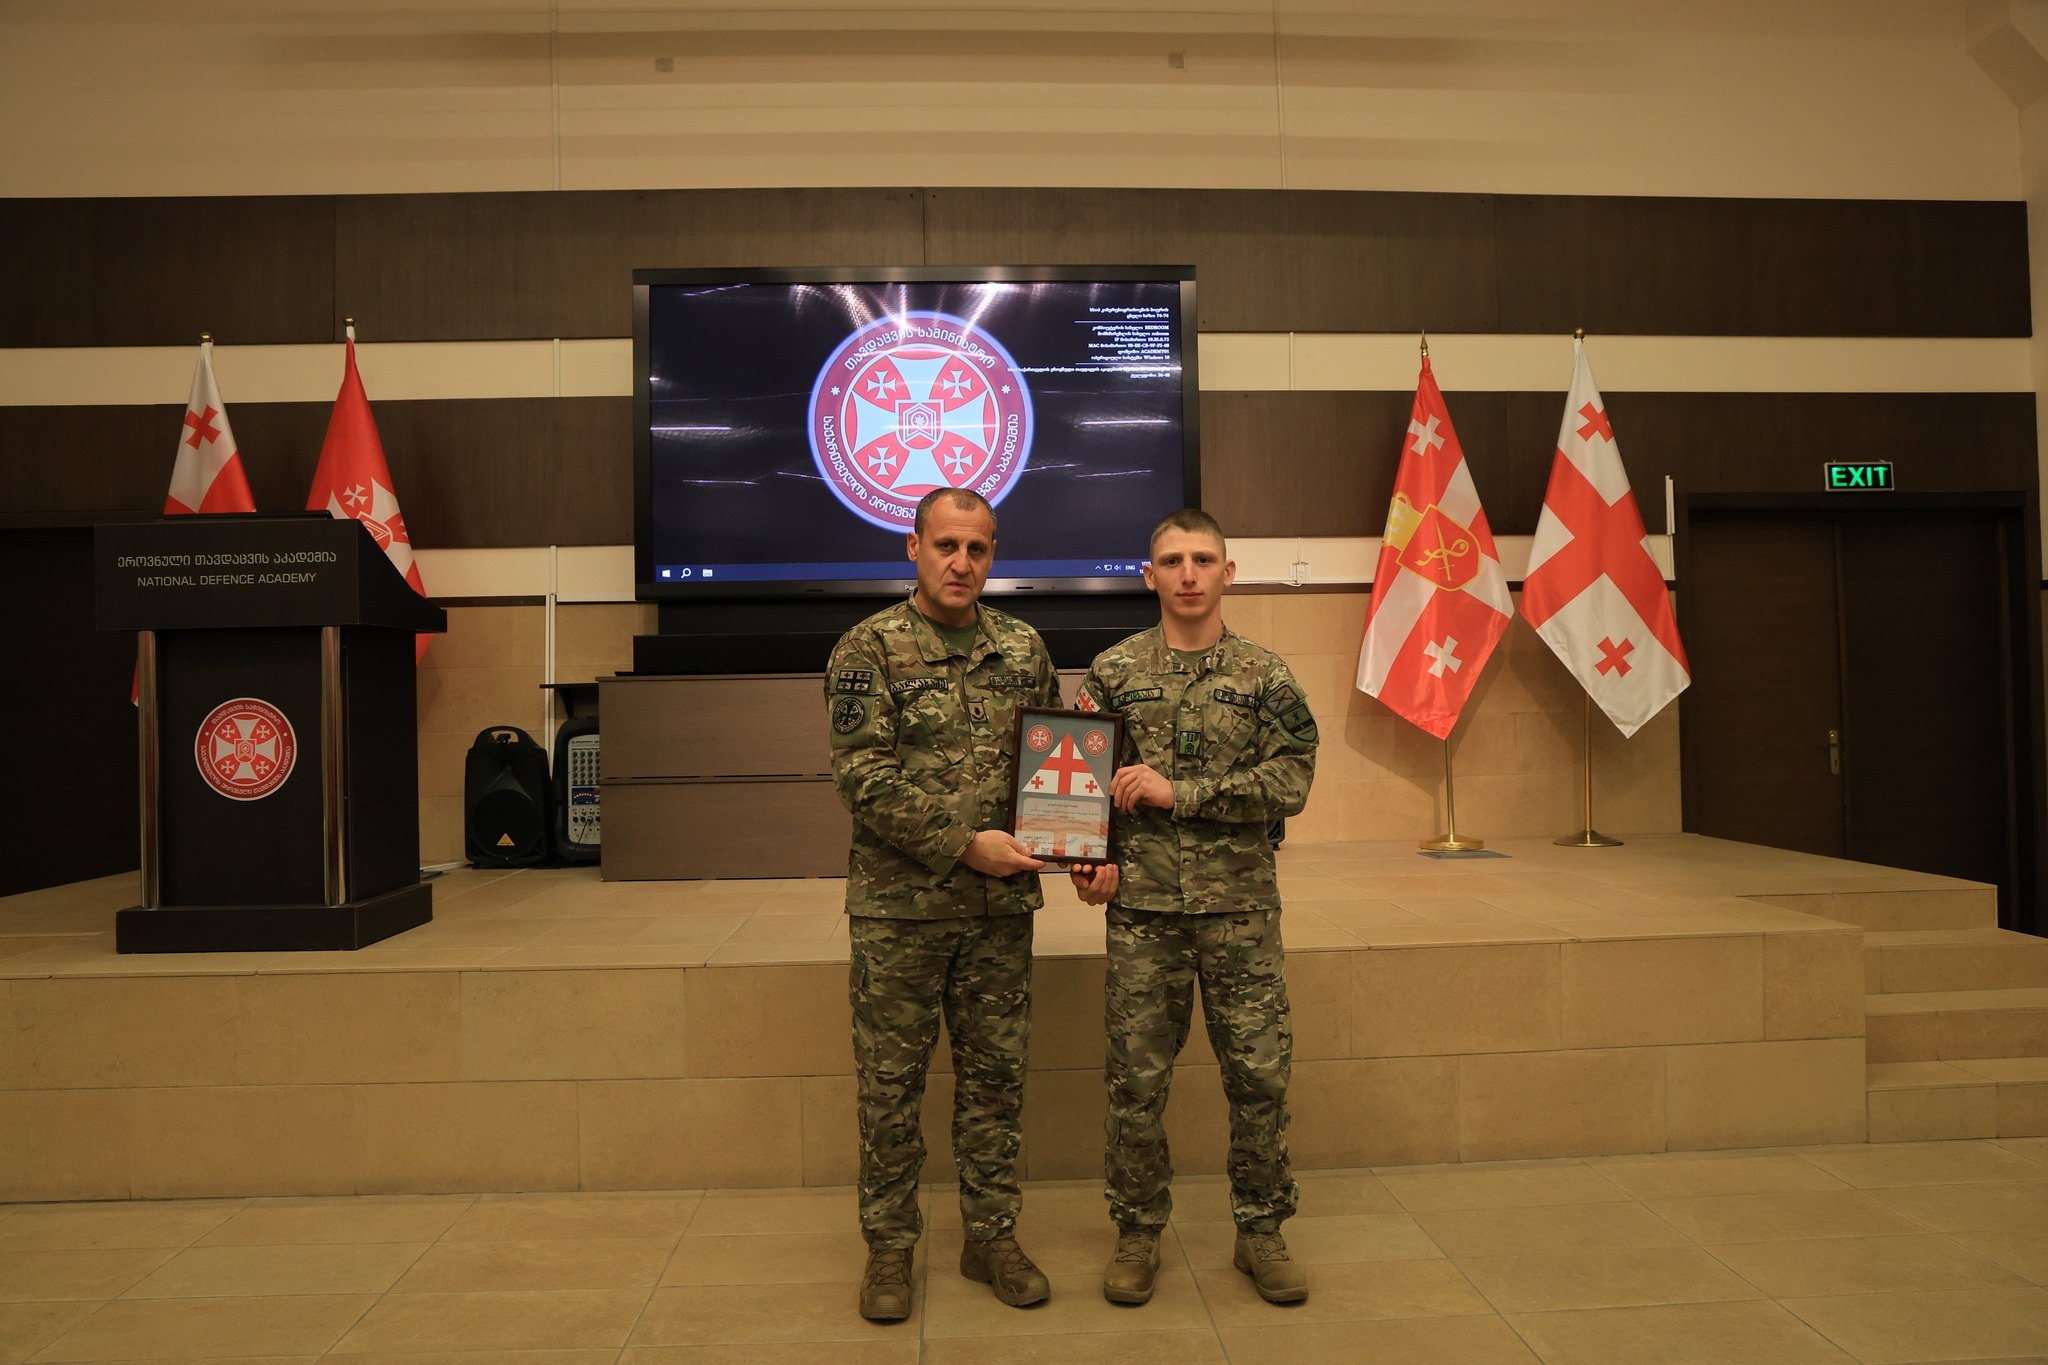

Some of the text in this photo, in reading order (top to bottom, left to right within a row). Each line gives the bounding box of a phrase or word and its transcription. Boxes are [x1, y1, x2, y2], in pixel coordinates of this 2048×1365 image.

[844, 326, 996, 371] თავდაცვის სამინისტრო
[998, 414, 1018, 472] აკადემია
[822, 415, 917, 520] საქართველოს ეროვნუ
[1832, 467, 1888, 486] EXIT
[118, 552, 337, 568] ეროვნული თავდაცვის აკადემია
[137, 573, 316, 587] NATIONAL DEFENCE ACADEMY
